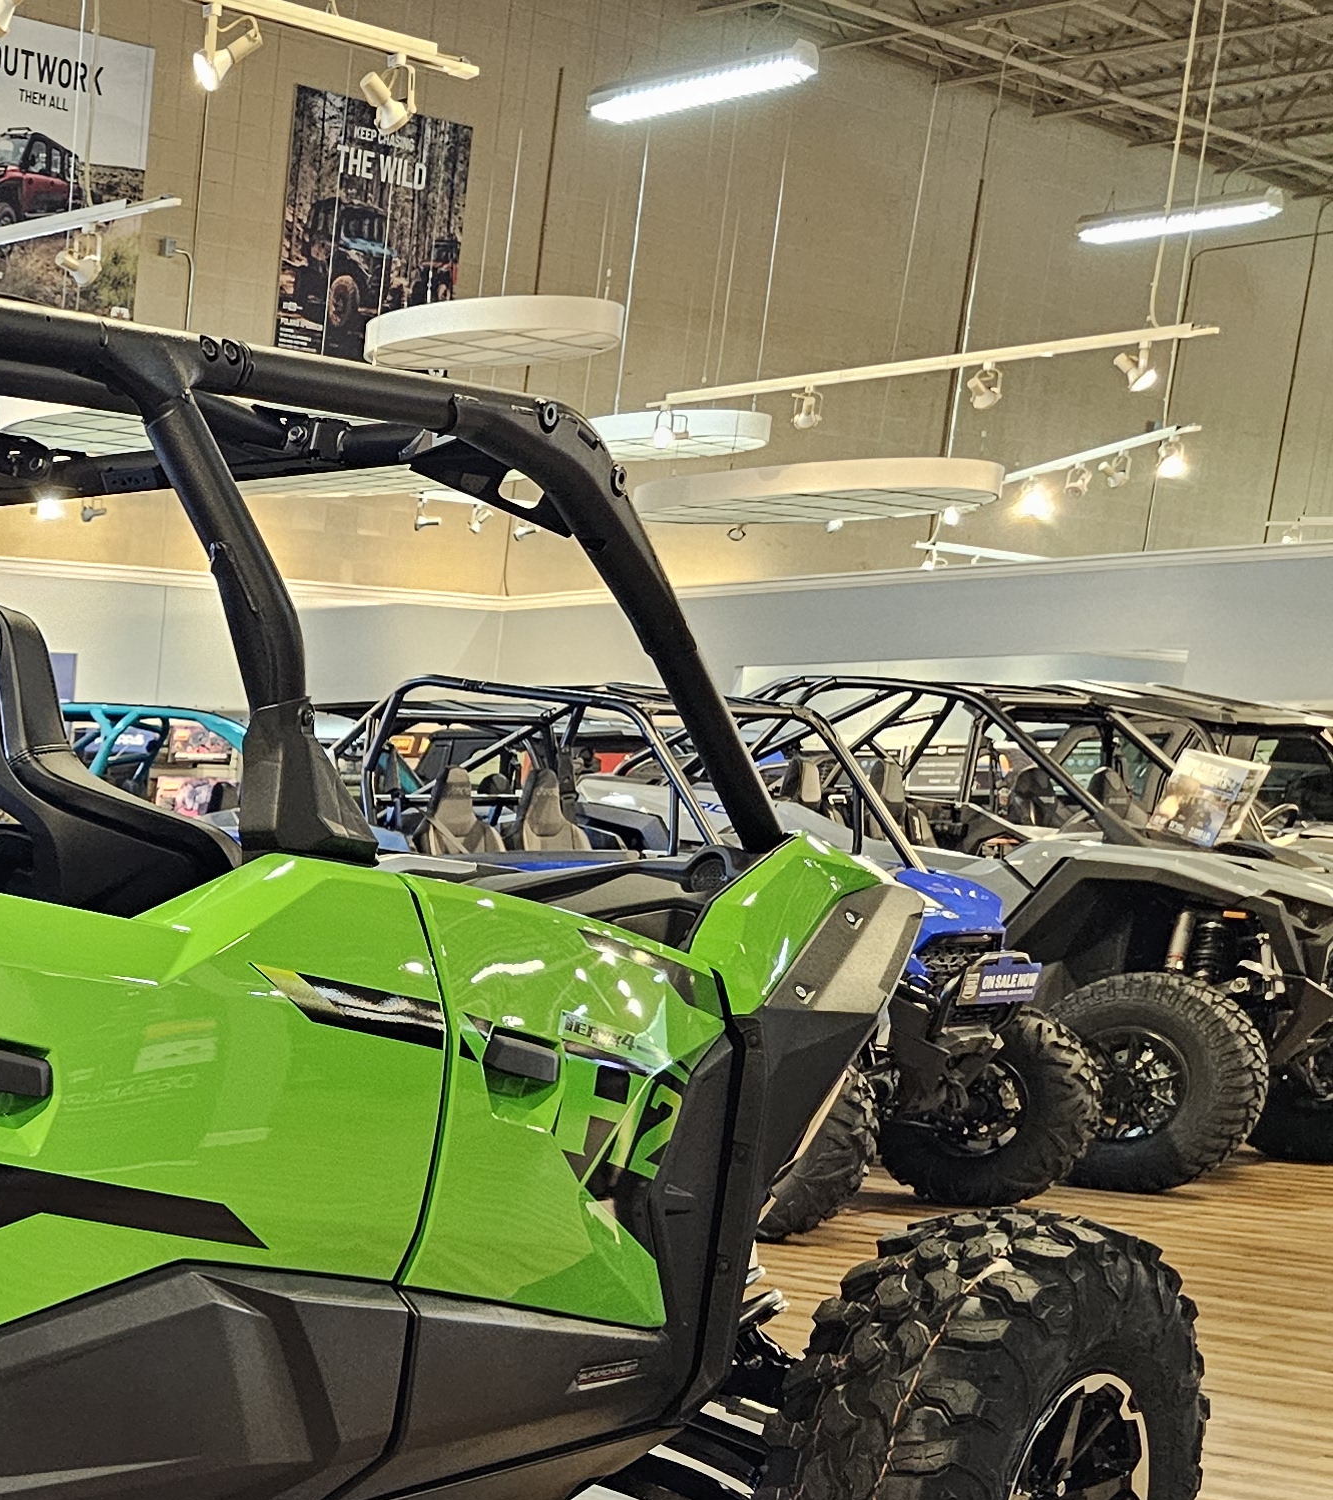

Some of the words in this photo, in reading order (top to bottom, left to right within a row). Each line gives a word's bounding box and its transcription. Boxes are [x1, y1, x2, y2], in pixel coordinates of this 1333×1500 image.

[19, 88, 47, 107] THEM
[48, 95, 69, 112] ALL
[353, 125, 377, 142] KEEP
[336, 143, 375, 180] THE
[379, 153, 427, 191] WILD
[981, 974, 996, 990] ON
[994, 973, 1019, 989] SALE
[1017, 971, 1040, 988] NOW
